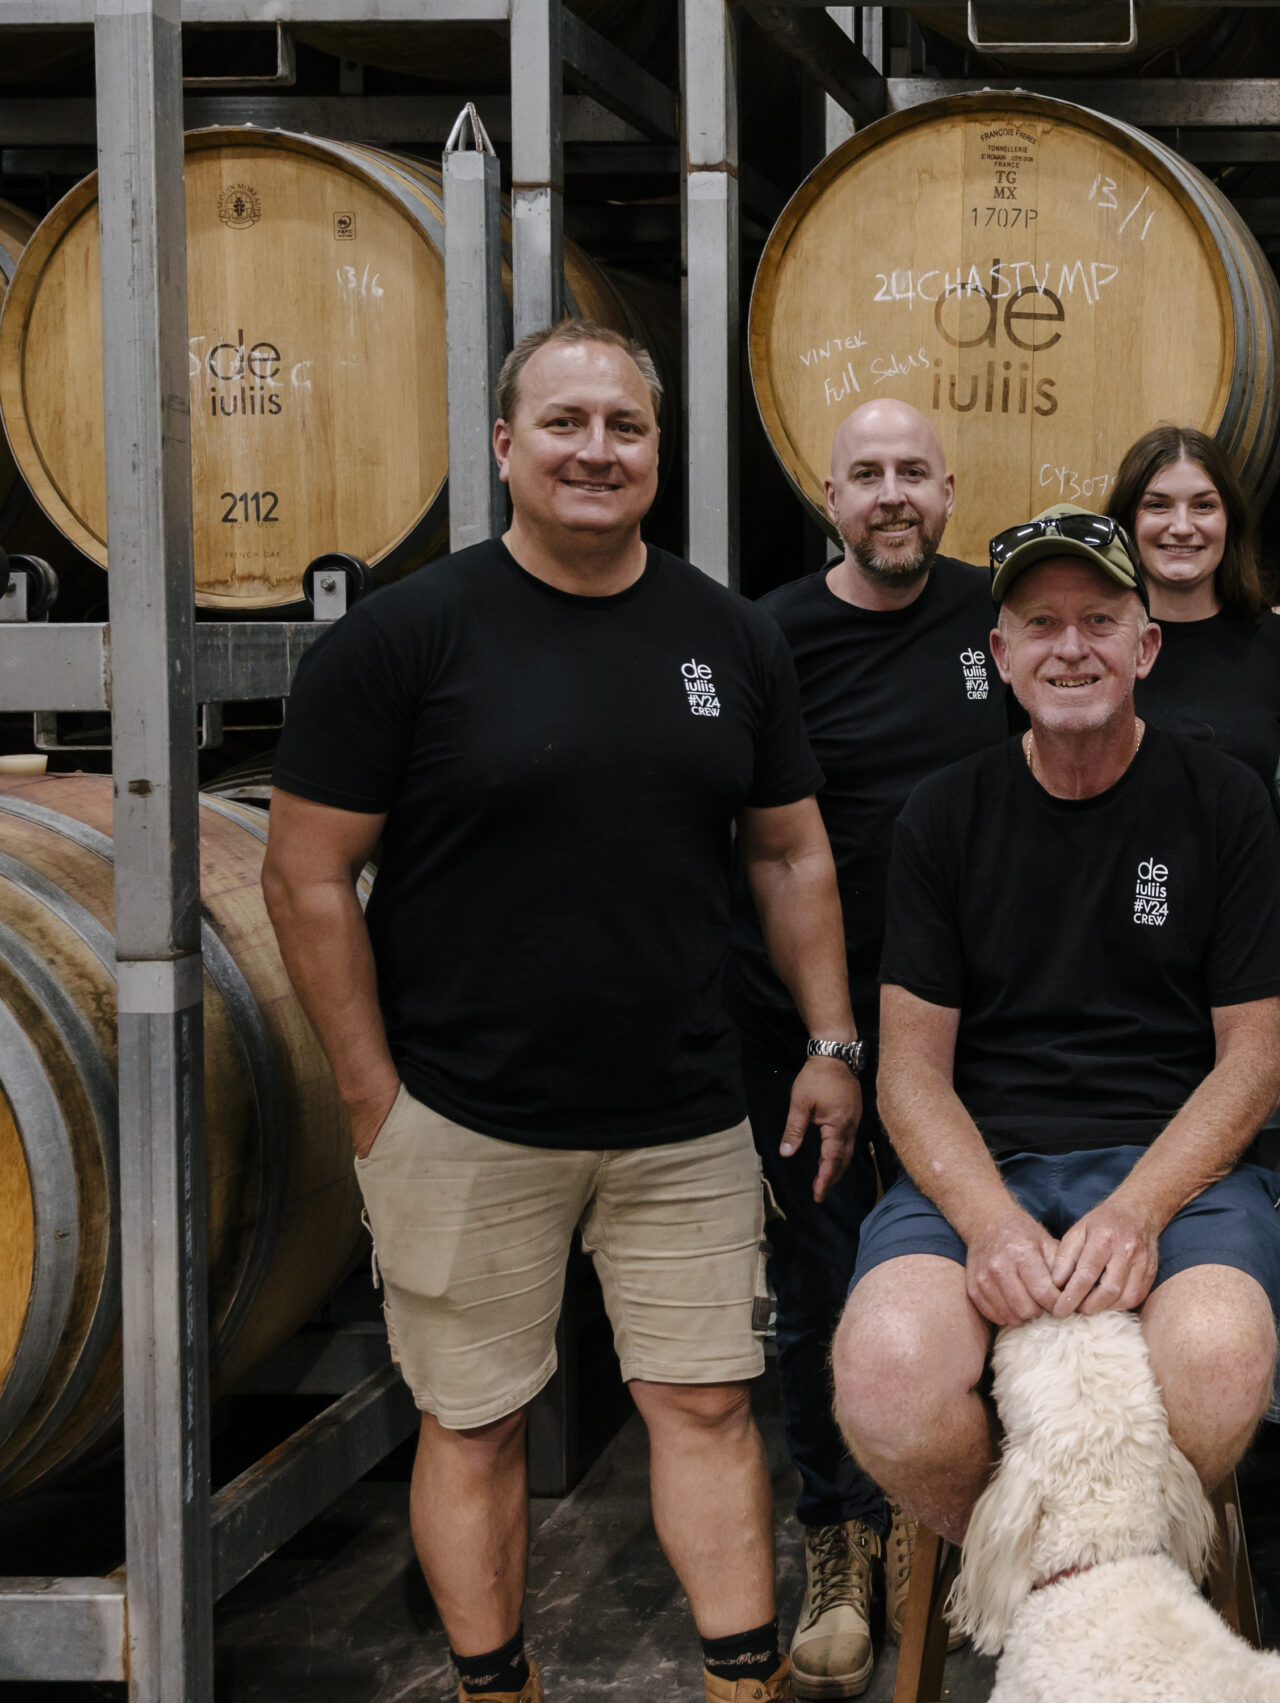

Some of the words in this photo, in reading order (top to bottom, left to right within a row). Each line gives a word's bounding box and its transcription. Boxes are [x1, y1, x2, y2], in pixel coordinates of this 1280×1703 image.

[988, 145, 1028, 153] TONNELLERIE
[995, 170, 1017, 184] TG
[993, 186, 1018, 200] MX
[971, 207, 1038, 229] 1707P
[934, 258, 1065, 352] de
[208, 328, 281, 381] de
[932, 357, 1059, 417] iuliis
[210, 386, 282, 417] iuliis
[220, 491, 279, 523] 2112
[960, 647, 986, 665] de
[681, 658, 712, 679] de
[962, 666, 987, 677] iuliis
[684, 678, 716, 693] iuliis
[965, 680, 989, 691] #V24
[688, 694, 721, 709] #V24
[967, 691, 988, 700] CREW
[691, 706, 720, 718] CREW
[1137, 857, 1169, 882] de
[1136, 880, 1167, 898] iuliis
[1133, 898, 1169, 917] #V24
[1133, 912, 1167, 926] CREW
